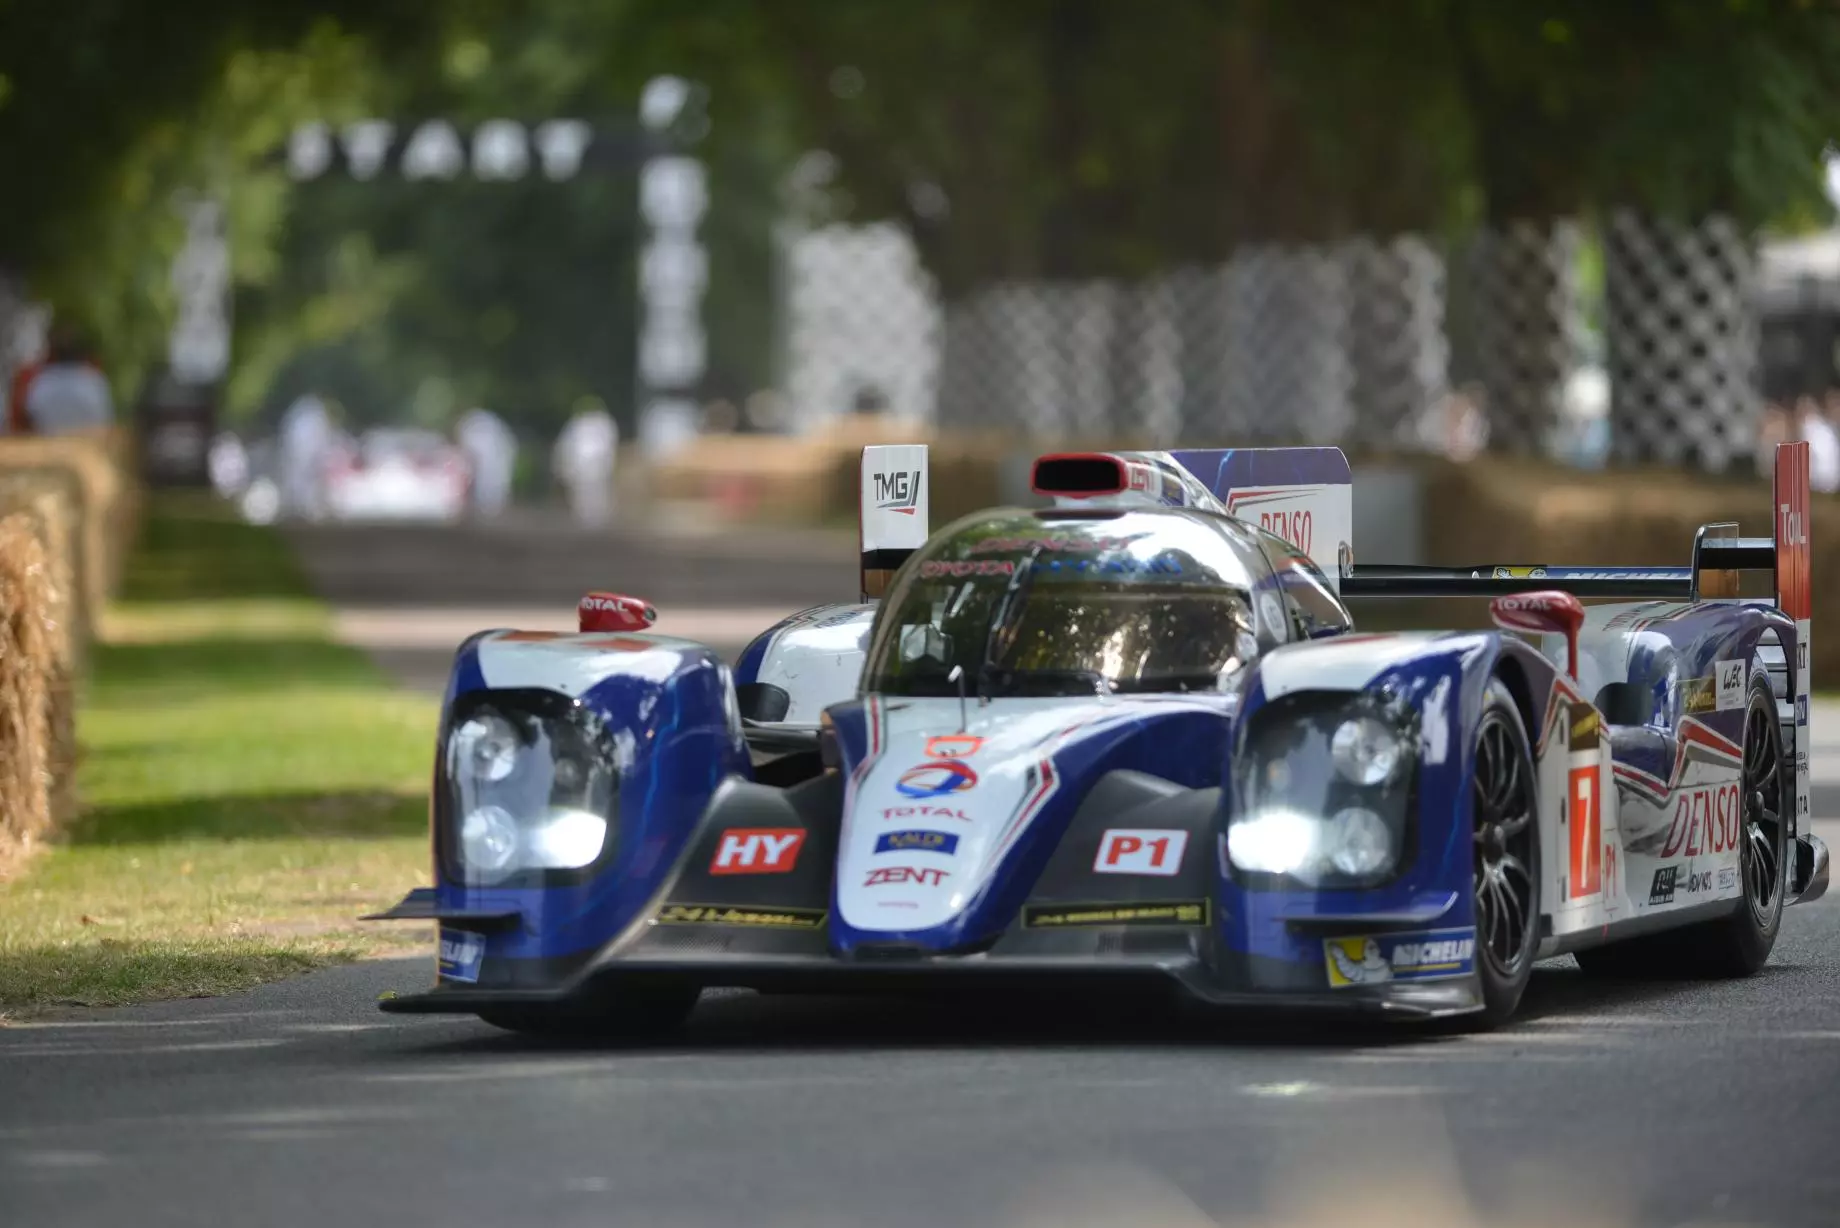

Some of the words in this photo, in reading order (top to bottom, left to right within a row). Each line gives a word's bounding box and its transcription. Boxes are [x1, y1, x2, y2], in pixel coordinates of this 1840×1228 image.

[874, 472, 908, 500] TMG
[881, 806, 974, 822] TOTAL
[1660, 784, 1738, 858] DENSO
[1577, 776, 1592, 889] 7
[716, 833, 800, 868] HY
[1105, 836, 1170, 868] P1
[862, 866, 951, 887] ZENT
[1392, 939, 1475, 965] MICHELIN
